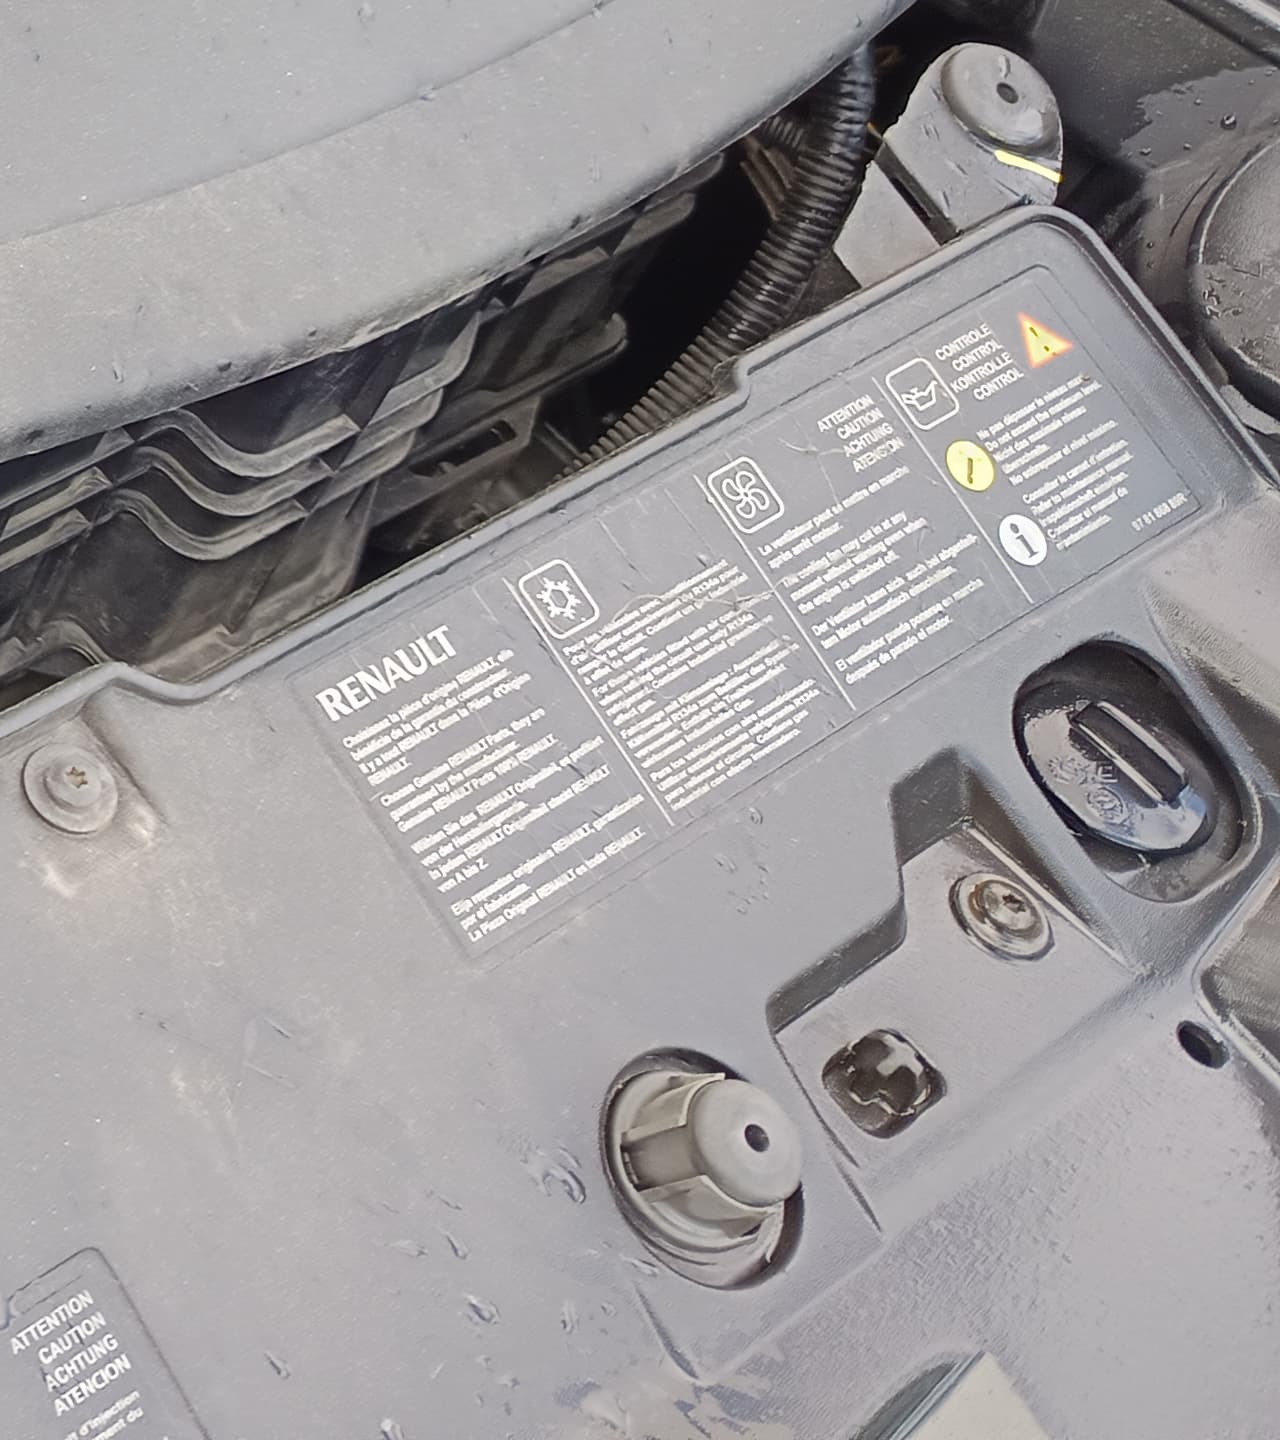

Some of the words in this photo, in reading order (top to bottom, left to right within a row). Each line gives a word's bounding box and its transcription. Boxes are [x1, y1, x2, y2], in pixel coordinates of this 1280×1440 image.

[935, 323, 993, 361] CONTROLE
[951, 338, 1004, 372] CONTROL
[949, 351, 1014, 393] KONTROLLE
[973, 367, 1025, 400] CONTROL
[817, 394, 875, 433] ATTENTION
[837, 407, 885, 440] CAUTION
[843, 422, 894, 458] ACHTUNG
[315, 624, 457, 722] RENAULT
[10, 1289, 94, 1355] ATTENTION
[38, 1311, 107, 1364] CAUTION
[45, 1333, 119, 1392] ACHTUNG
[54, 1353, 132, 1417] ATENCION
